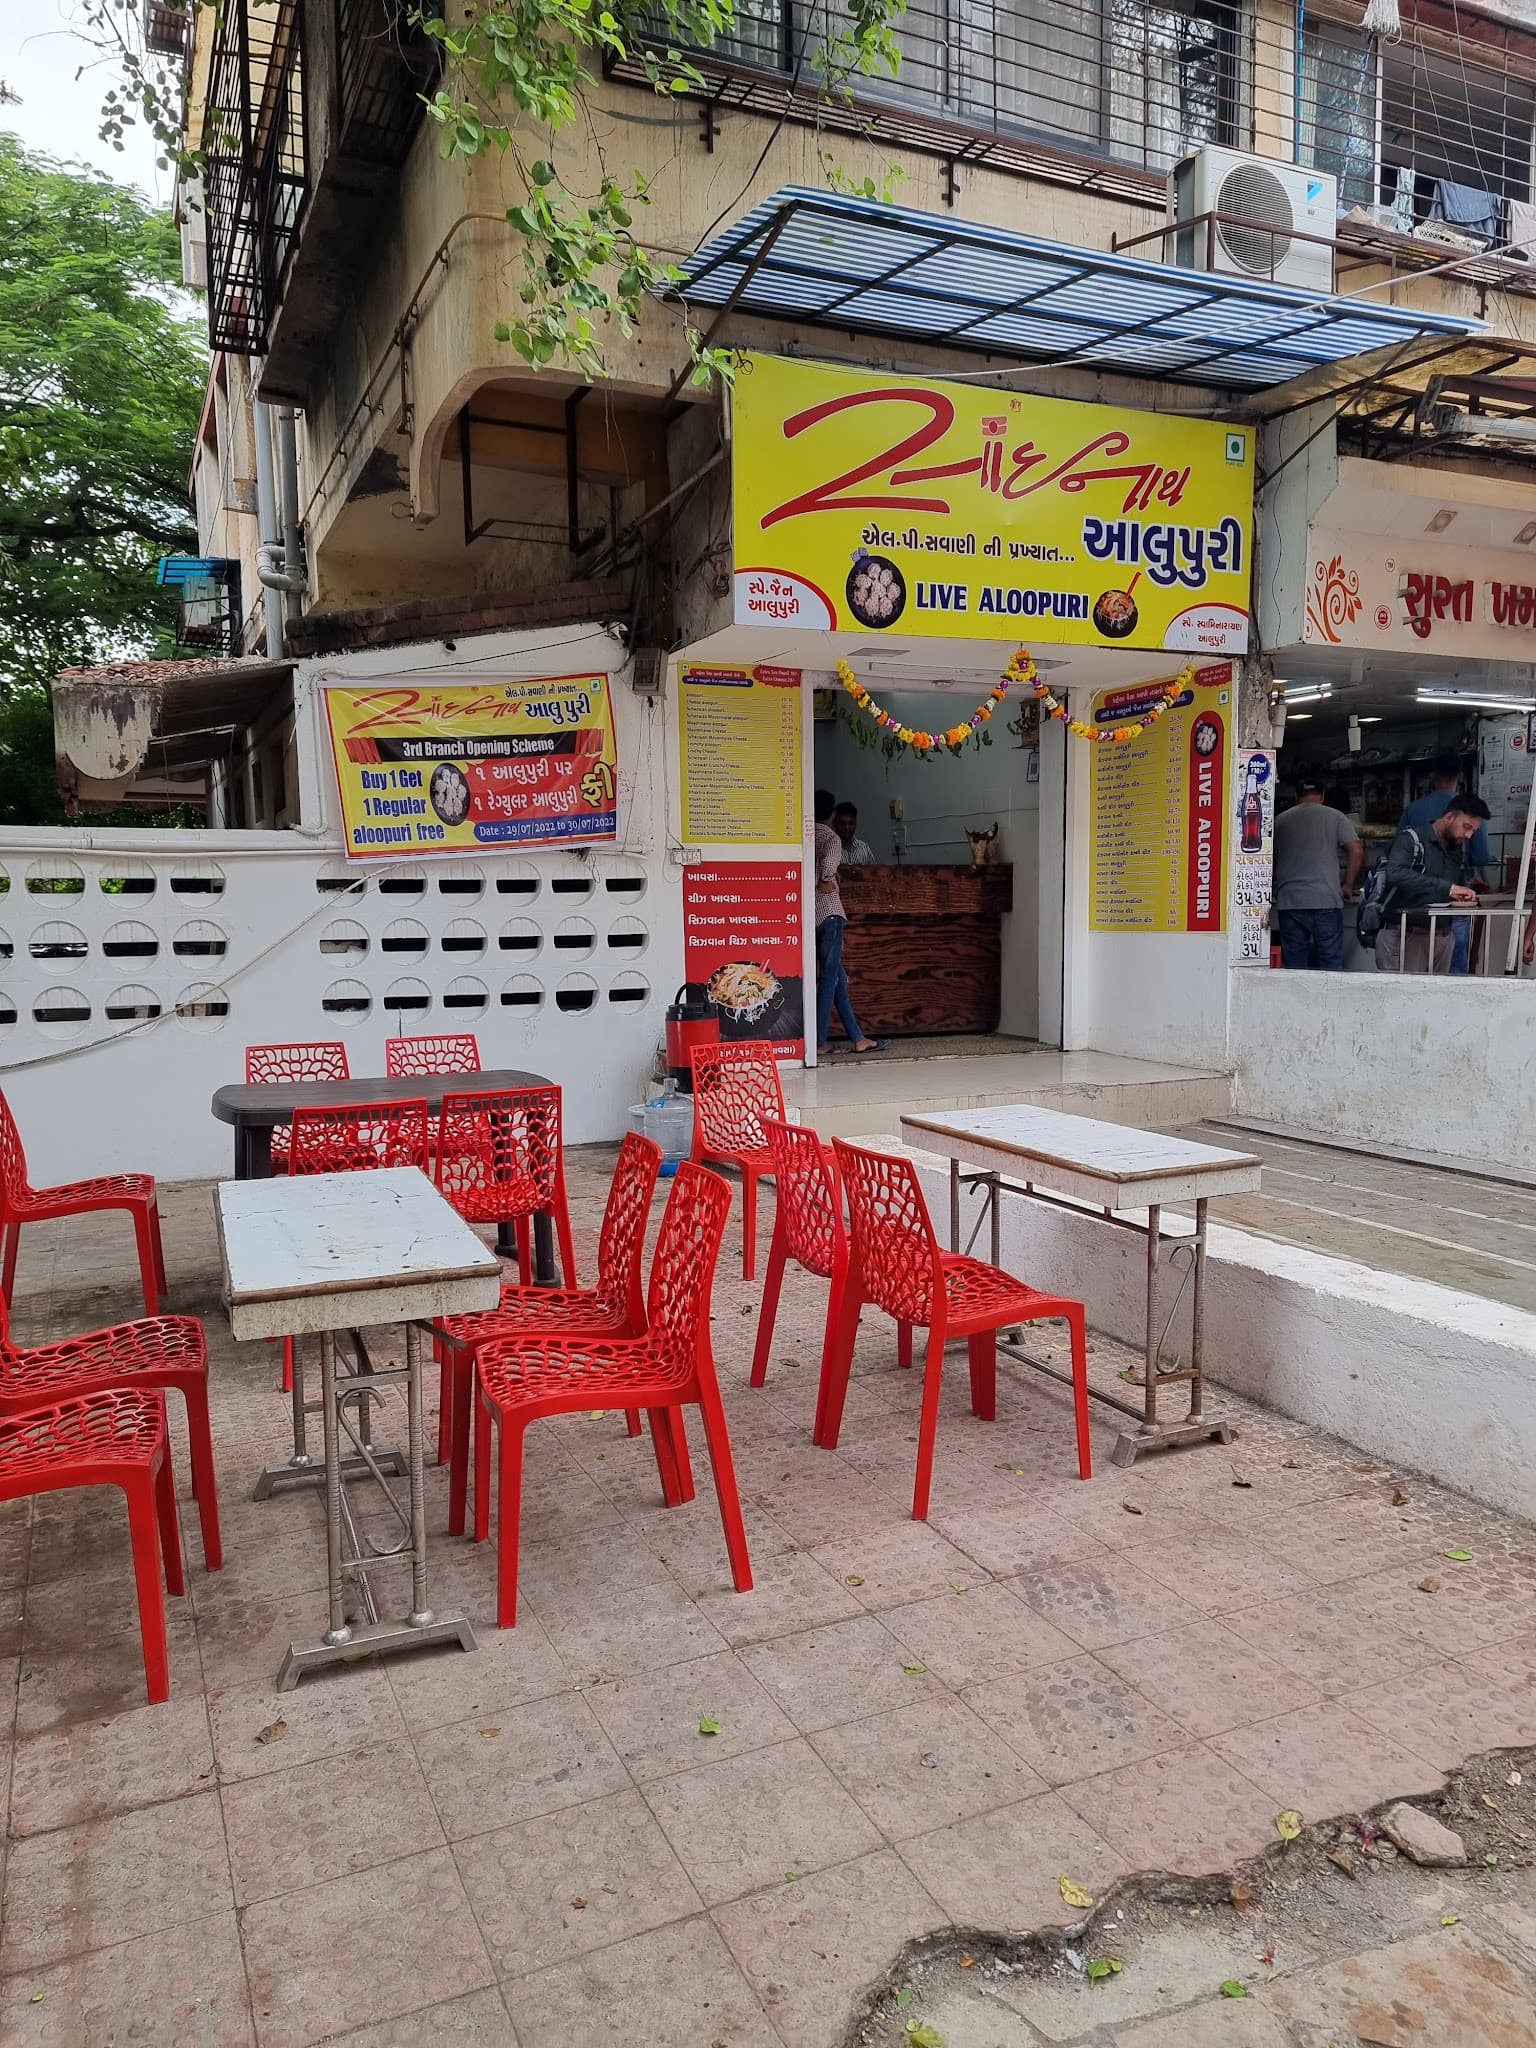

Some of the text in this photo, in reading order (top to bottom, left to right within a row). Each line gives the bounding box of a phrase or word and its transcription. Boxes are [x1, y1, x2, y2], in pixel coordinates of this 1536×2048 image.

[984, 533, 1001, 557] ની
[1083, 515, 1242, 588] આલુપુરી
[748, 599, 799, 618] આલુપુરી
[916, 582, 1089, 619] LIVE ALOOPURI
[1405, 573, 1474, 638] સુરત
[1198, 634, 1225, 646] આલુપુરી
[403, 738, 554, 757] 3rd Branch Opening Scheme
[361, 770, 423, 790] Buy 1 Get
[492, 758, 549, 784] આલુપુરી
[555, 760, 573, 776] પર
[363, 797, 426, 818] 1 Regular
[532, 786, 578, 813] આલુપુરી
[353, 823, 444, 846] aloopuri free
[480, 826, 499, 836] Date
[506, 821, 555, 836] 29/07/2022
[558, 820, 566, 830] to
[568, 816, 615, 832] 30/07/2022
[1196, 762, 1212, 920] LIVE ALOOPURI
[785, 871, 796, 881] 40
[786, 892, 797, 902] 60
[786, 914, 797, 924] 50
[786, 935, 798, 946] 70
